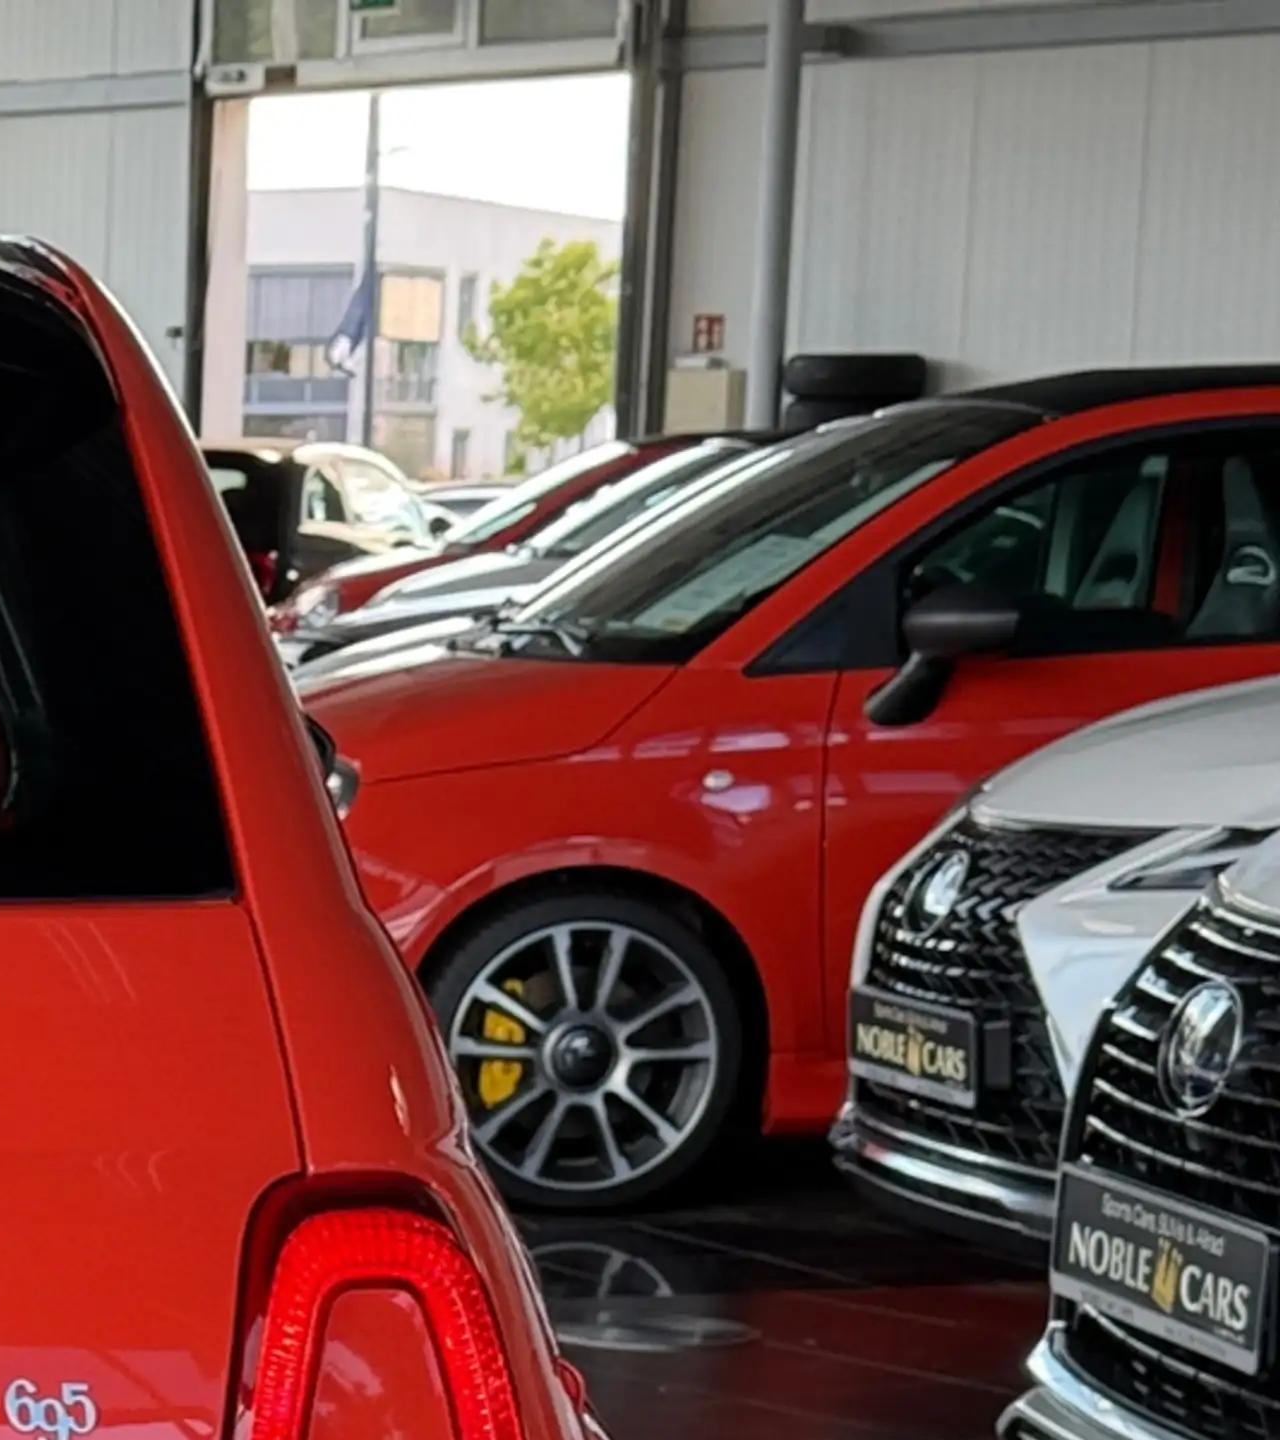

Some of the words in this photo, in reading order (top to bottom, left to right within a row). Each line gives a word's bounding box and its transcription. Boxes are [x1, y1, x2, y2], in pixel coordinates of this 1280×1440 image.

[856, 1022, 907, 1066] NOBLE
[922, 1041, 967, 1082] CARS
[1068, 1220, 1153, 1293] NOBLE
[1179, 1264, 1251, 1331] CARS
